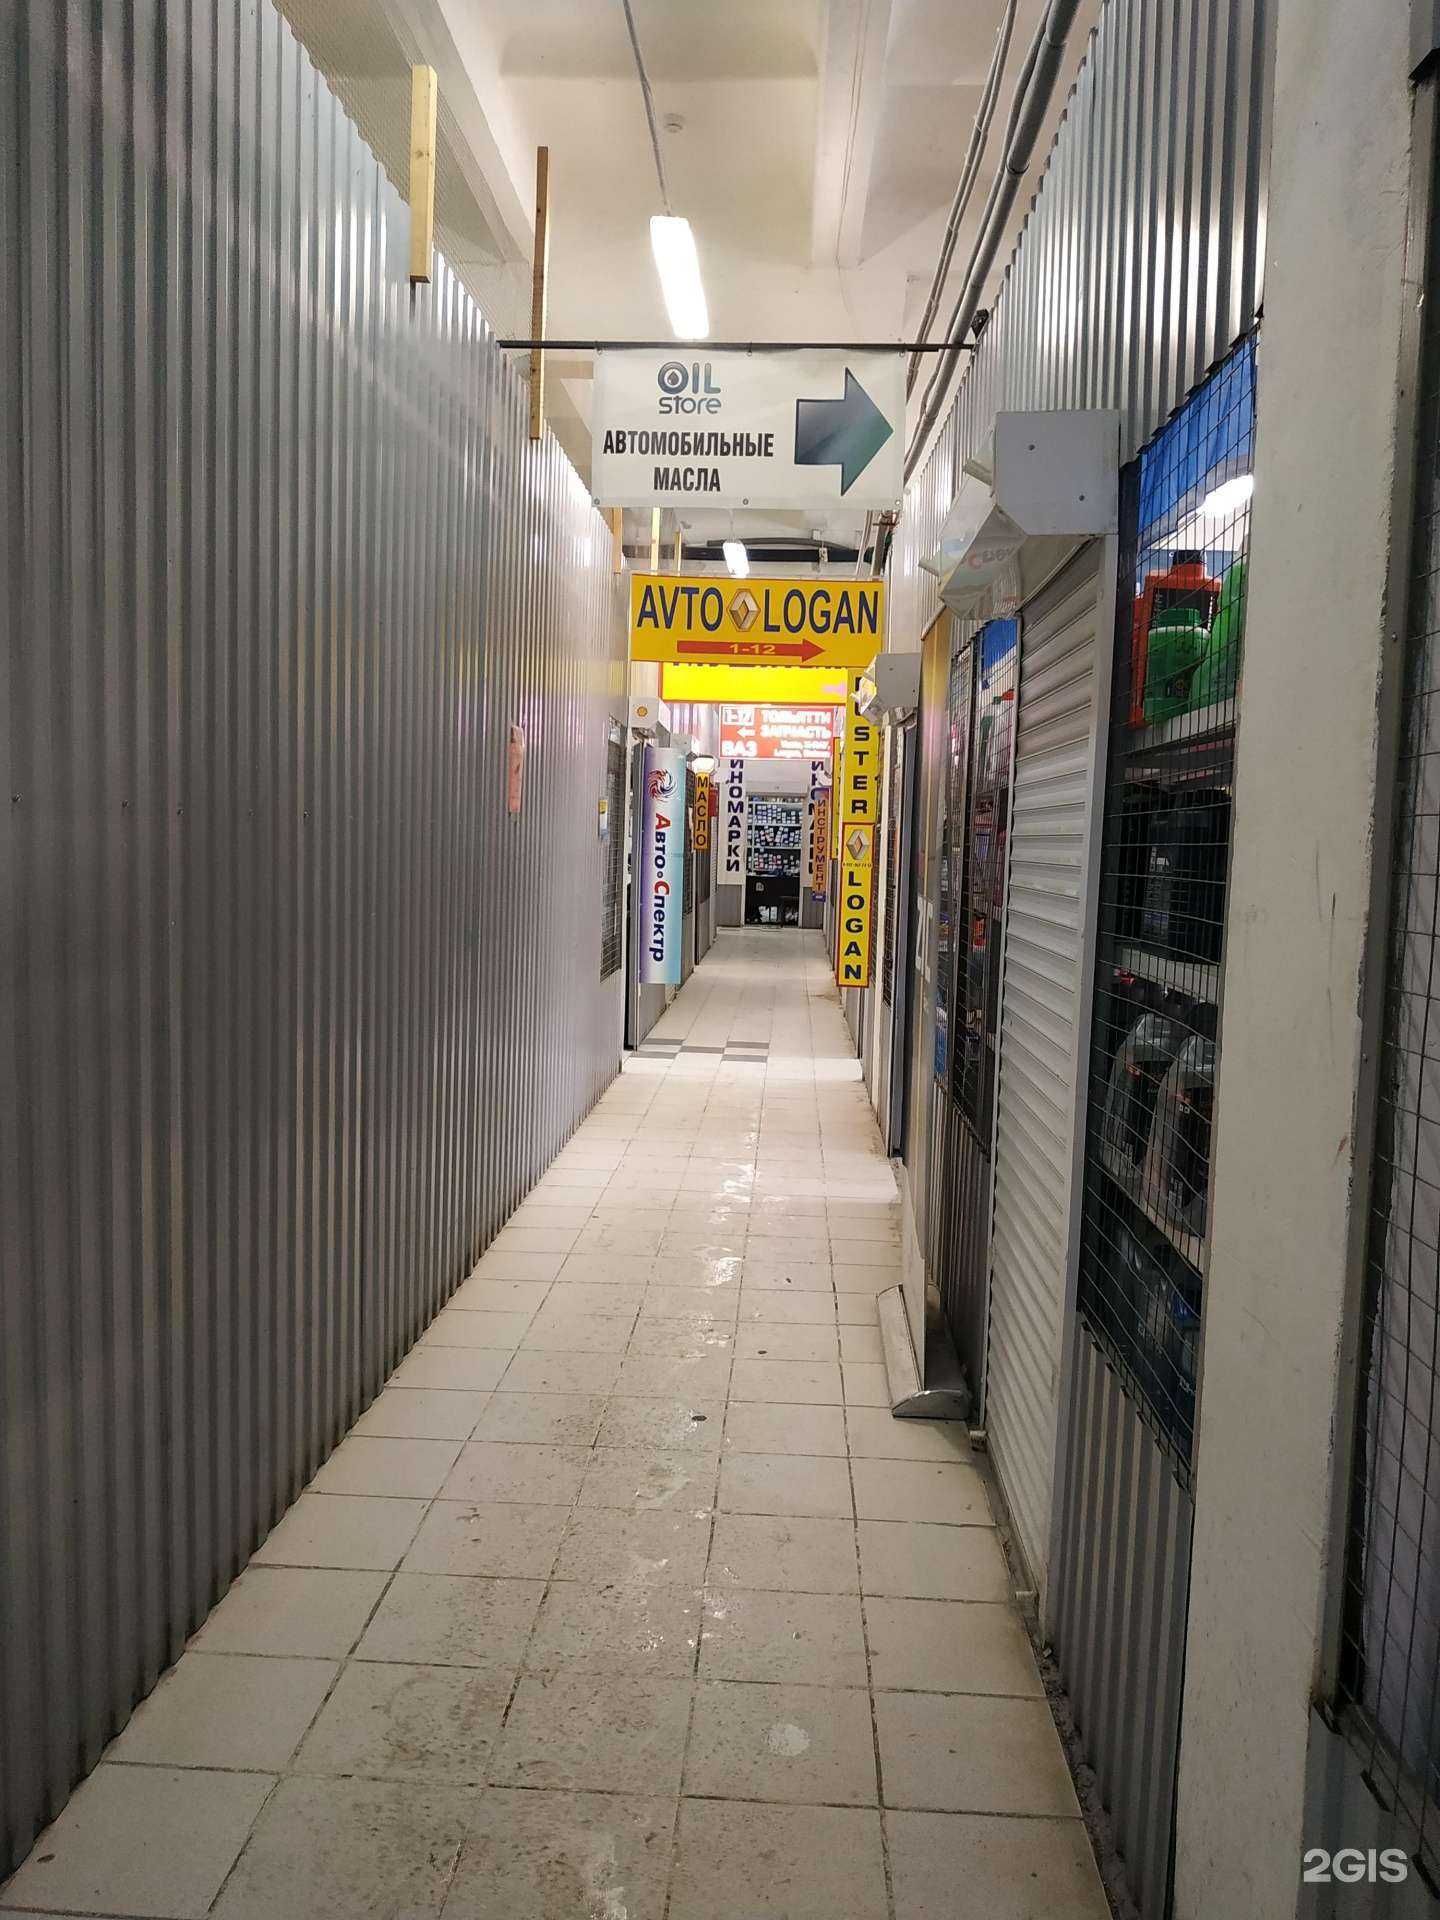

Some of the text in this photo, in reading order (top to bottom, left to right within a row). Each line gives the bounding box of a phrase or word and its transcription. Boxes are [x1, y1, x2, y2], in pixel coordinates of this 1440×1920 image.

[657, 361, 721, 394] OIL
[603, 430, 774, 457] АВТОМОБИЛЬНЫЕ
[653, 467, 721, 492] МАСЛА
[637, 585, 879, 634] AVTO LOGAN
[729, 643, 776, 654] 1-12
[722, 740, 757, 756] ВАЗ
[852, 677, 869, 814] STER
[696, 776, 708, 846] МАСЛО
[726, 759, 744, 872] ИНОМАРКИ
[816, 800, 826, 890] ИНСТРУМЕНТ
[844, 871, 865, 979] LOGAN
